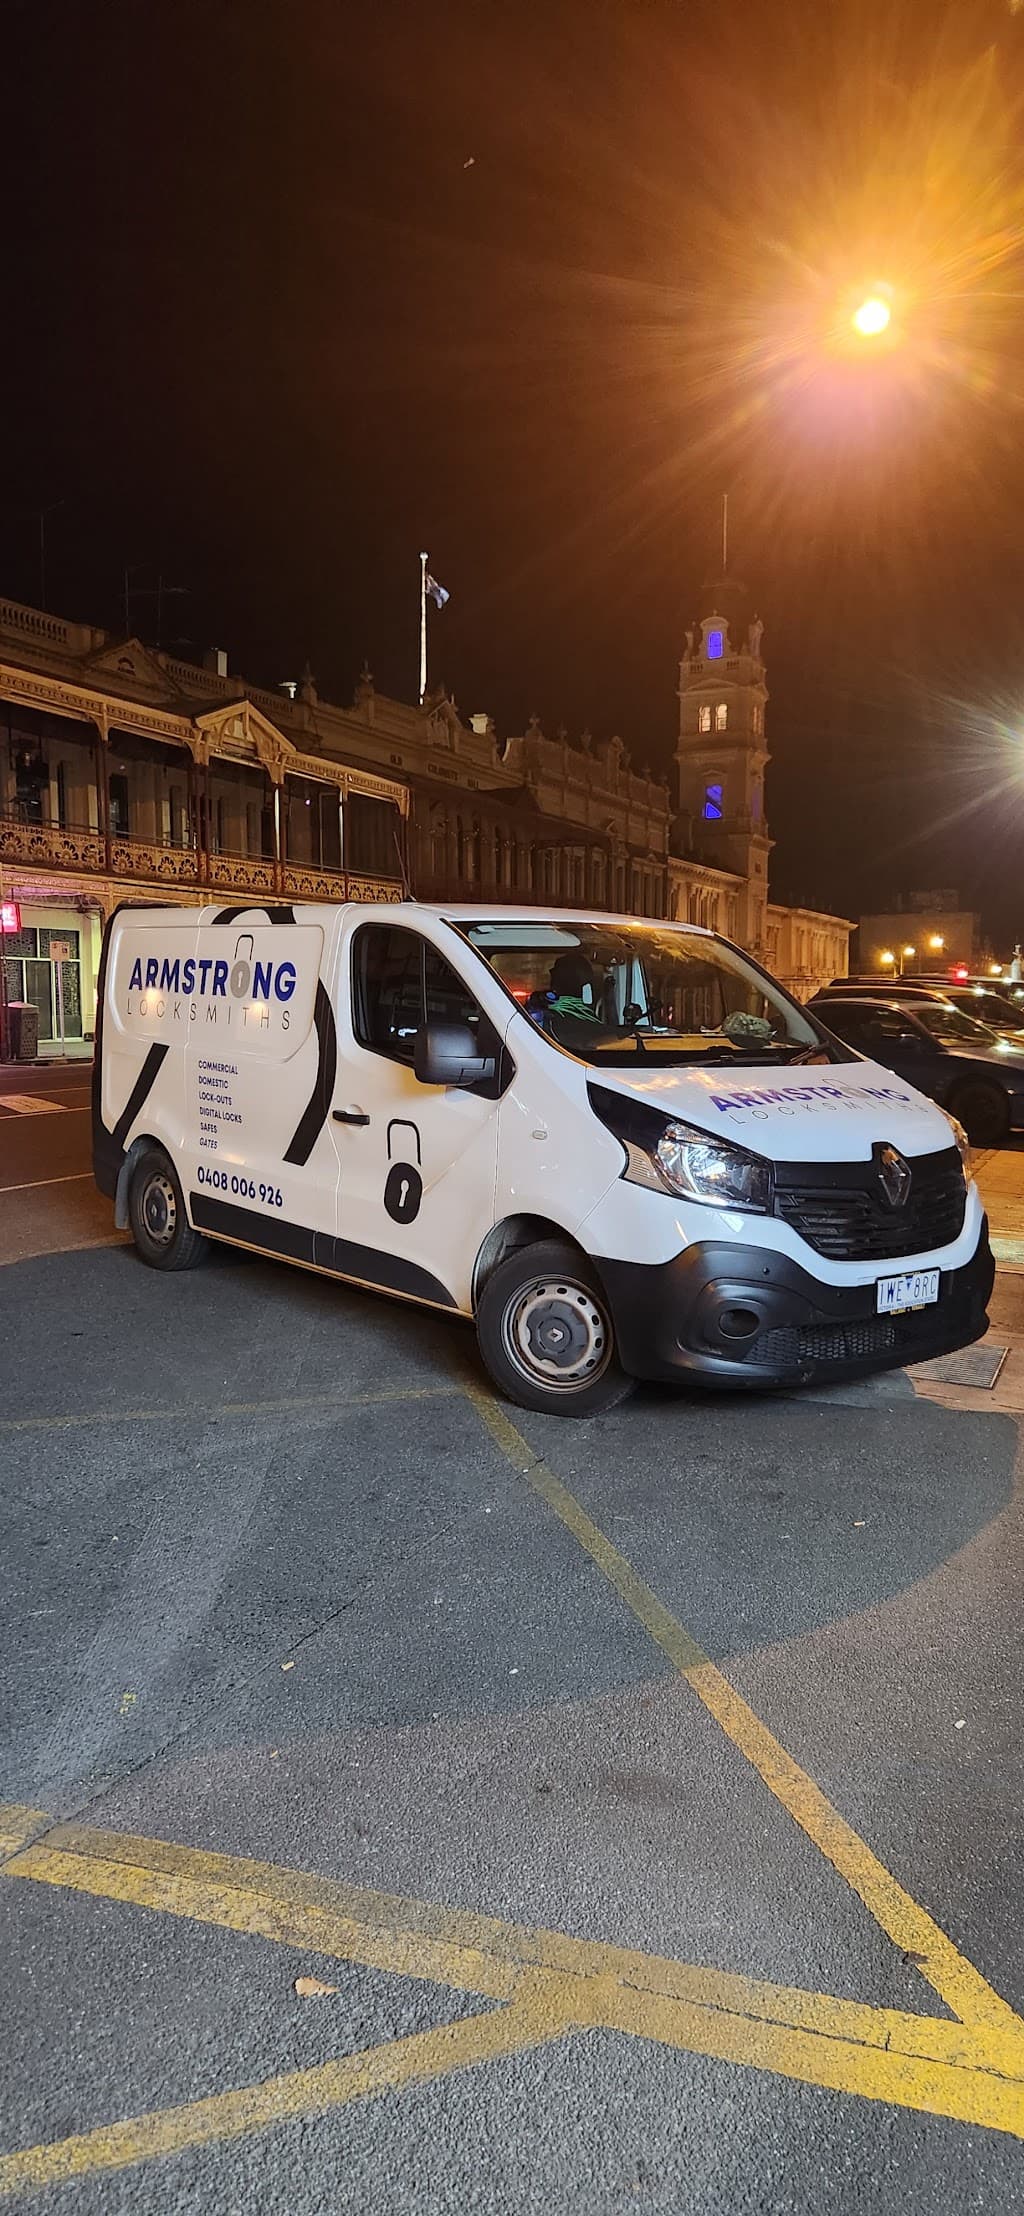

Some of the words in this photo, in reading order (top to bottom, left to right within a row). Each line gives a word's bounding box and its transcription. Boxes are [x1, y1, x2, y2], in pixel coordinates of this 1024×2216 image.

[128, 957, 297, 1002] ARMSTRONG
[126, 999, 291, 1030] LOCKSMITHS
[198, 1060, 239, 1076] COMMERCIAL
[198, 1075, 229, 1090] DOMESTIC
[198, 1091, 233, 1106] LOCK-OUTS
[709, 1086, 911, 1112] ARMSTRONG
[199, 1106, 222, 1120] DIGITAL
[222, 1111, 243, 1124] LOCKS
[728, 1101, 929, 1125] LOCKSMITHS
[200, 1122, 218, 1134] SAFES
[199, 1137, 218, 1150] GATES
[197, 1166, 229, 1191] 0408
[231, 1176, 256, 1199] 006
[258, 1183, 283, 1207] 926
